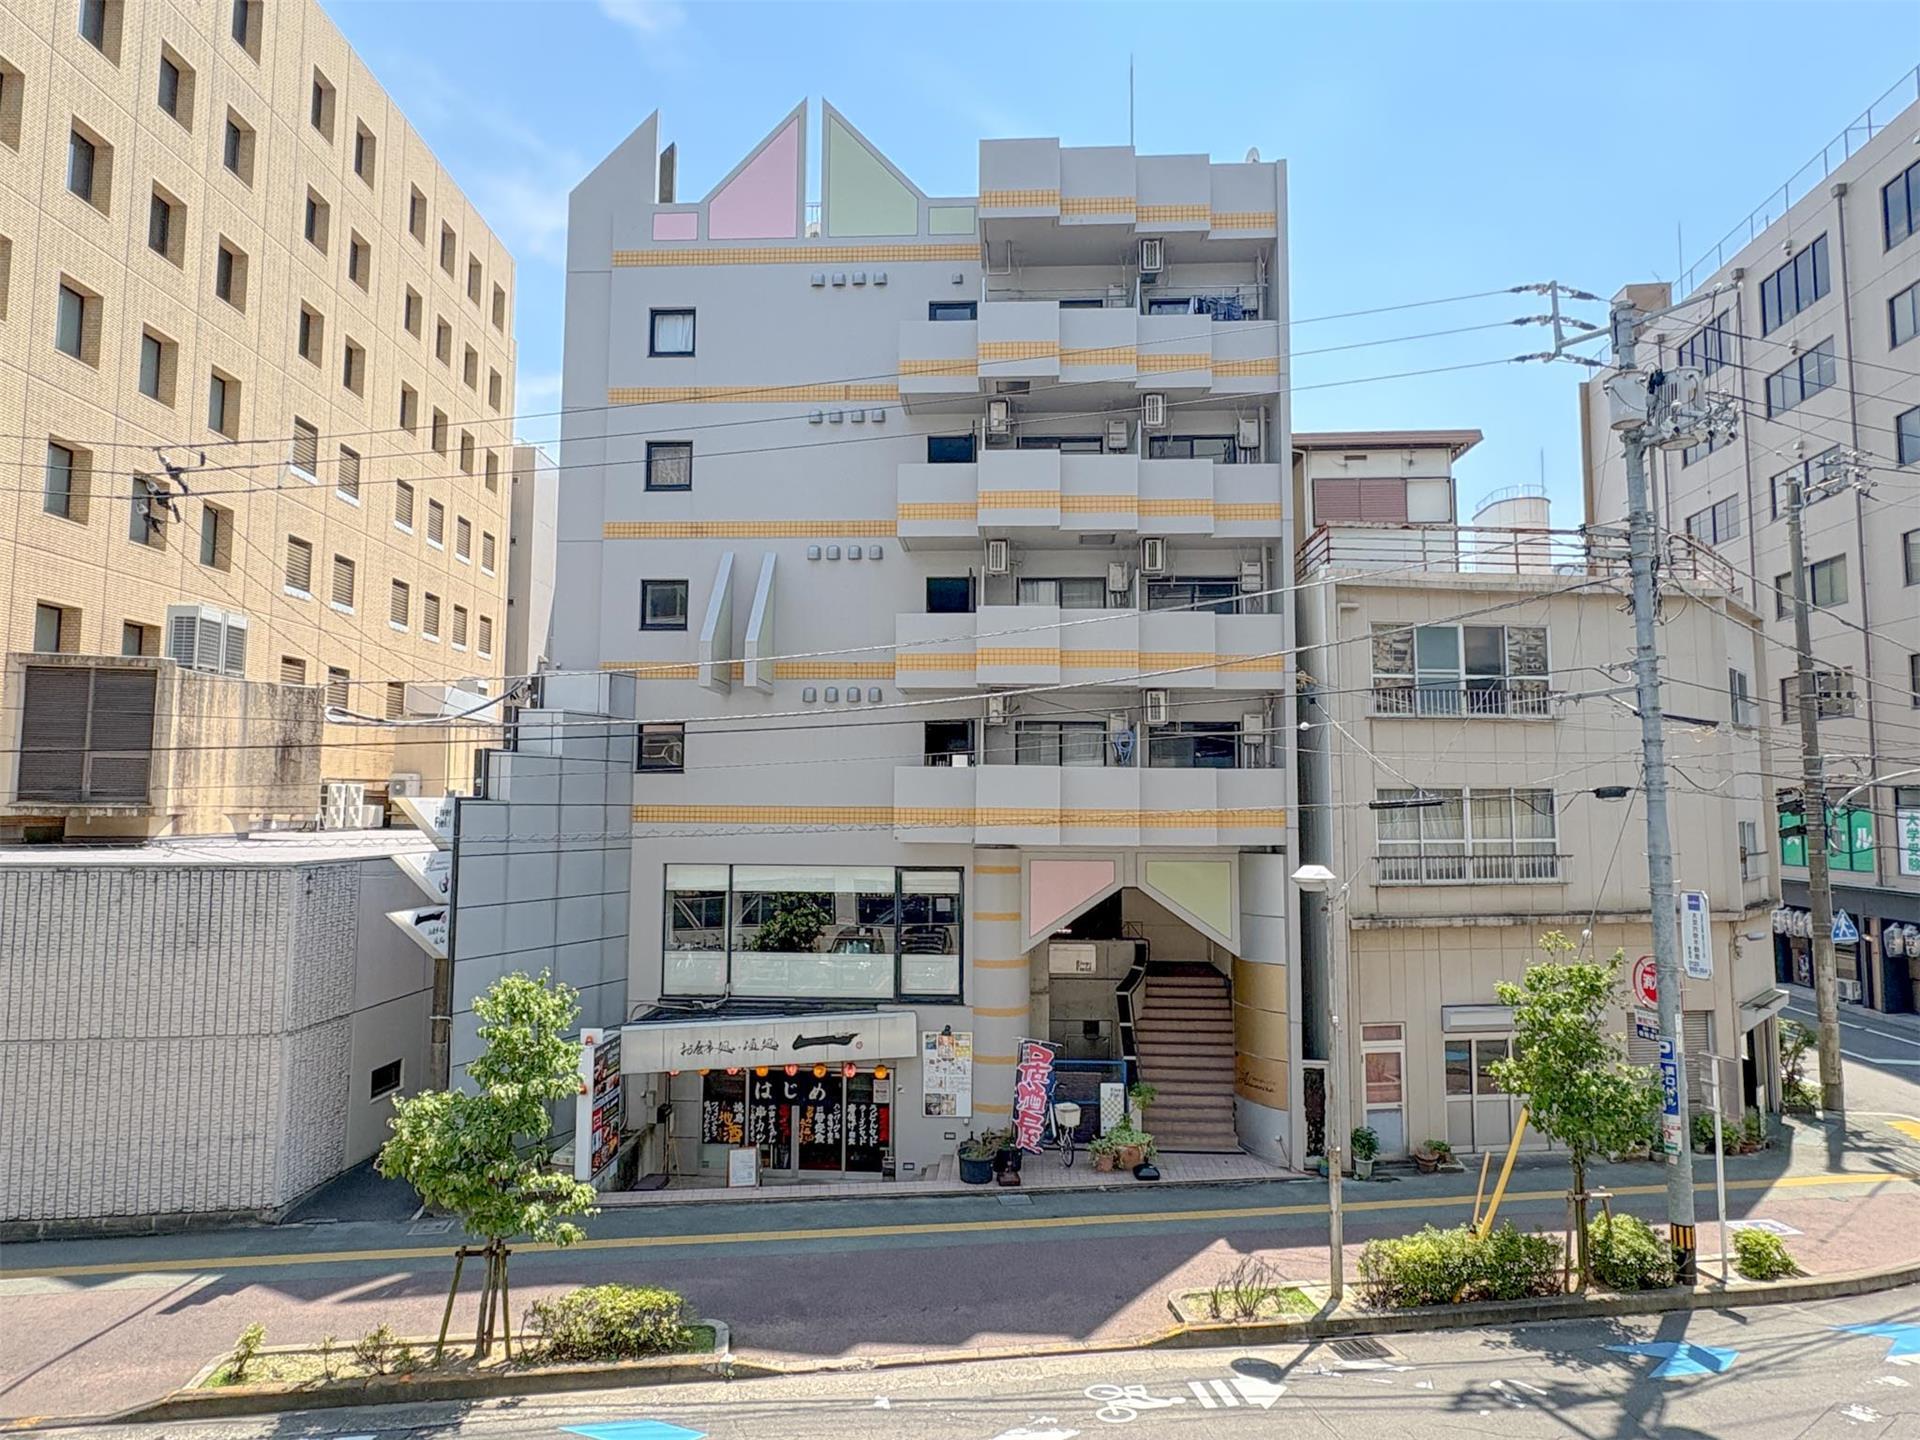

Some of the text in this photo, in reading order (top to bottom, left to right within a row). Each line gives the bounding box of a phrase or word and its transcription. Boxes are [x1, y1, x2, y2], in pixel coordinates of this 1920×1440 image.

[755, 1081, 826, 1100] はじめ
[755, 1105, 767, 1143] 串カツ
